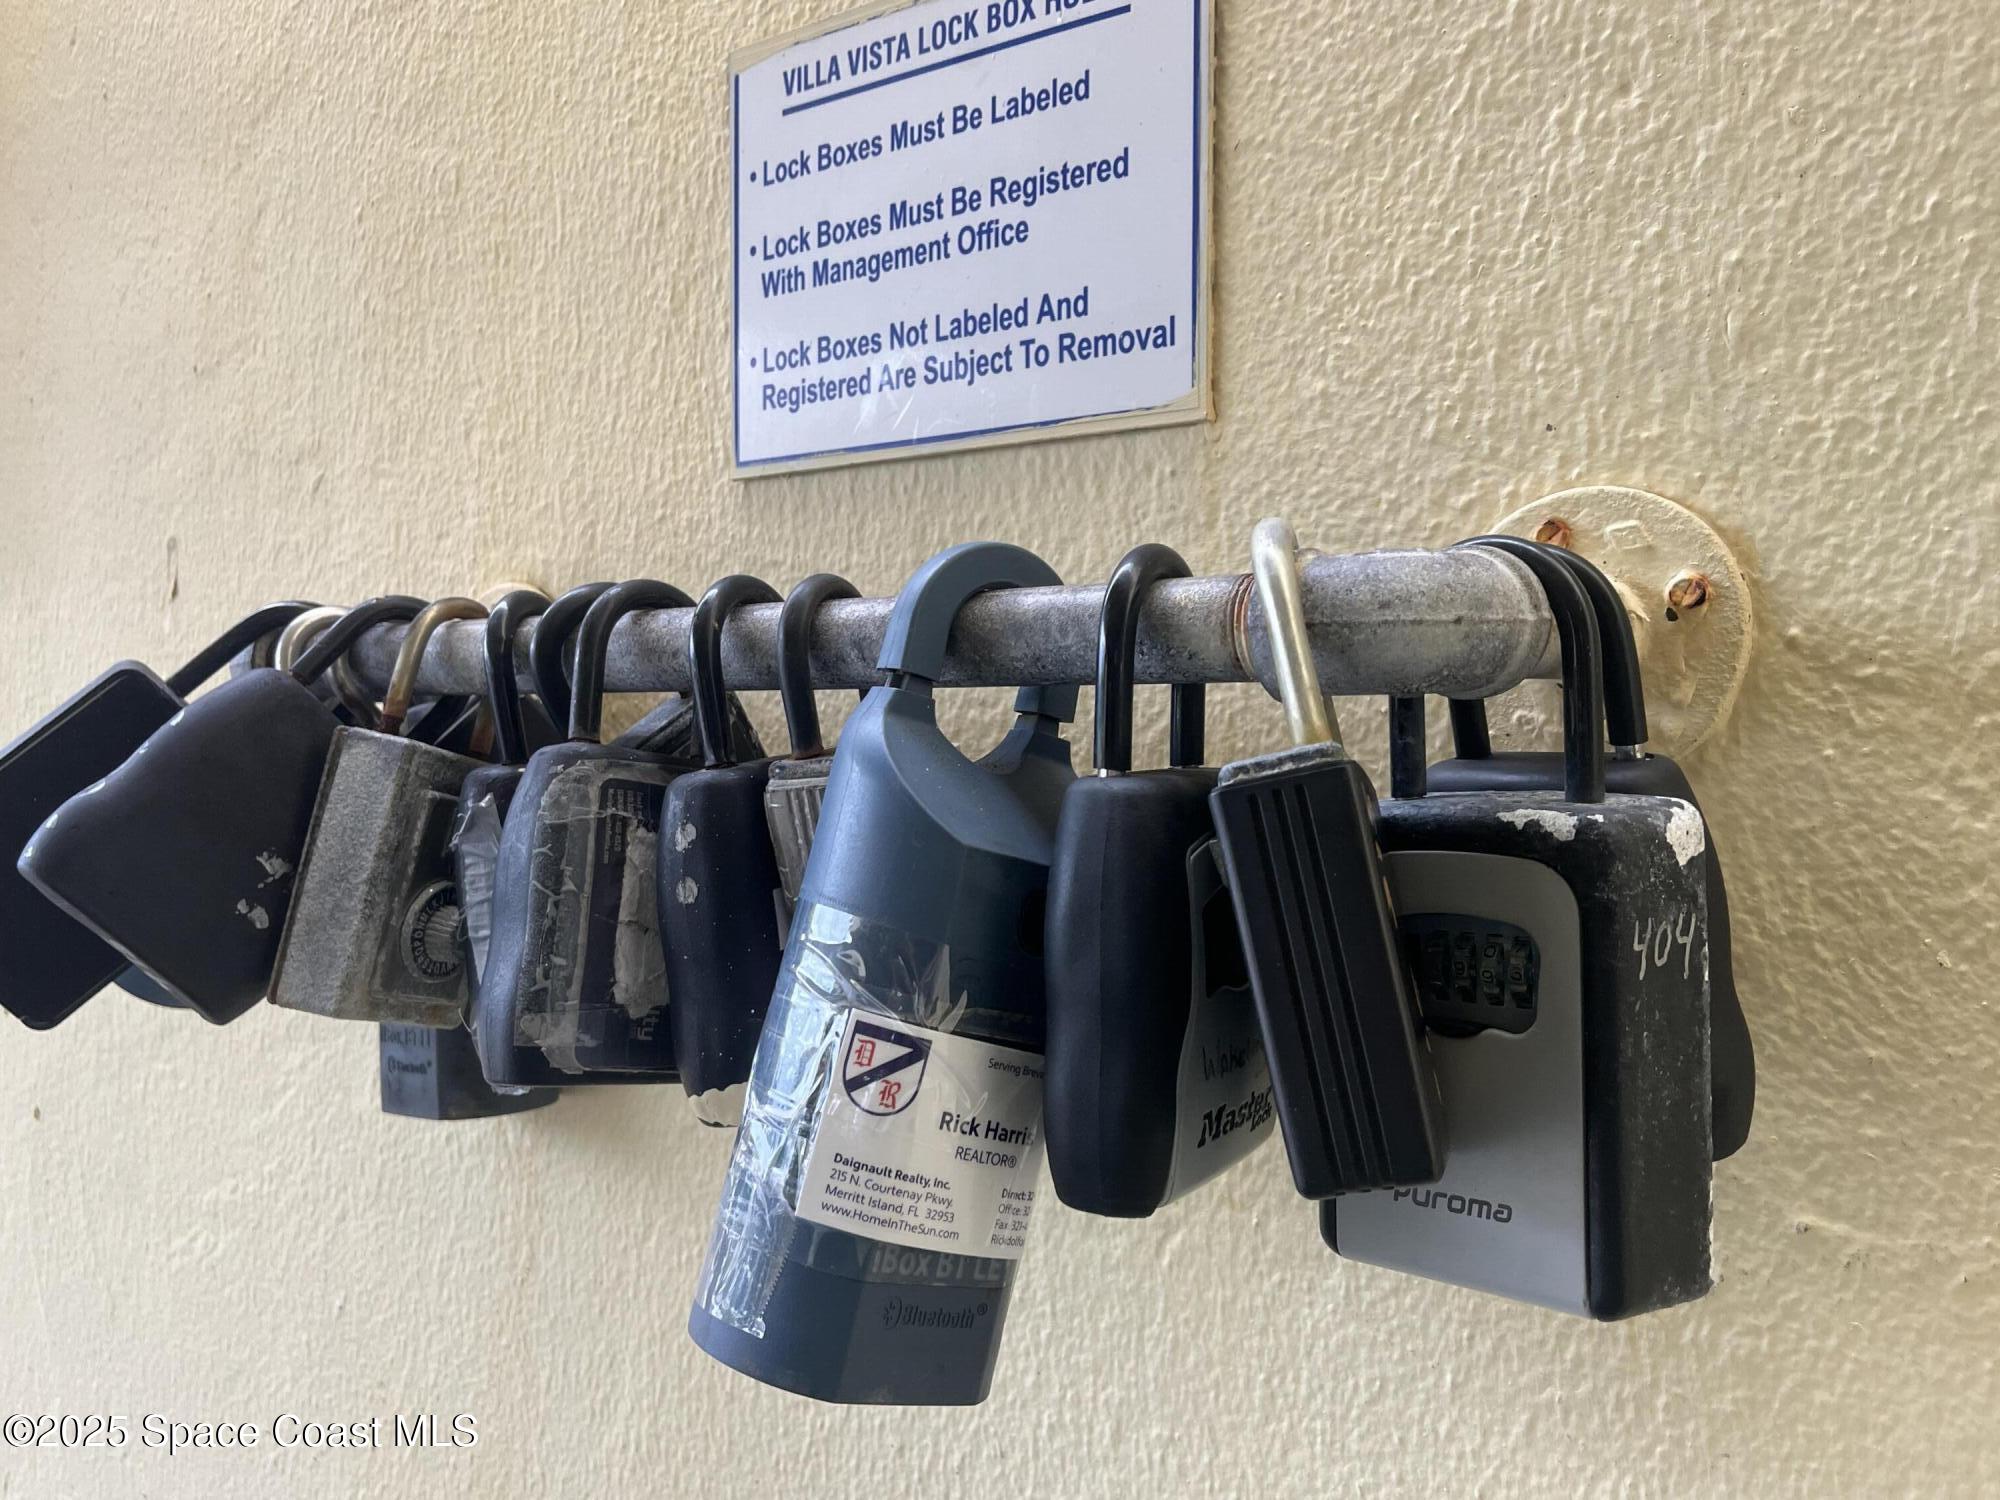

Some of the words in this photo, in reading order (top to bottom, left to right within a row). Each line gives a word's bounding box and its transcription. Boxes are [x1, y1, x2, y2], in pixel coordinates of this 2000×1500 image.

[783, 55, 841, 97] VILLA
[848, 33, 910, 78] VISTA
[919, 9, 979, 56] LOCK
[987, 0, 1036, 33] BOX
[763, 150, 811, 187] Lock
[817, 134, 882, 172] Boxes
[890, 112, 945, 153] Must
[952, 105, 982, 135] Be
[991, 69, 1090, 124] Labeled
[763, 226, 811, 261] Lock
[817, 212, 882, 248] Boxes
[889, 192, 944, 231] Must
[951, 185, 981, 216] Be
[989, 147, 1129, 207] Registered
[761, 266, 806, 298] With
[812, 232, 950, 288] Management
[957, 217, 1029, 255] Office
[763, 340, 811, 373] Lock
[817, 329, 882, 363] Boxes
[889, 318, 928, 351] Not
[935, 297, 1028, 342] Labeled
[1036, 286, 1089, 324] And
[762, 367, 871, 413] Registered
[878, 363, 916, 393] Are
[923, 343, 1012, 387] Subject
[1019, 338, 1050, 369] To
[1058, 315, 1176, 365] Removal
[1633, 913, 1697, 981] 404
[853, 1038, 876, 1067] D
[988, 1058, 1021, 1077] Serving
[879, 1080, 901, 1109] R
[1197, 1083, 1273, 1149] Master
[939, 1111, 981, 1137] Rick
[829, 1168, 848, 1183] 215
[849, 1175, 860, 1187] N.
[864, 1178, 922, 1203] Courtenay
[833, 1152, 892, 1178] Daignault
[894, 1169, 931, 1189] Realty,
[821, 1201, 960, 1240] www.HomeInTheSun.com
[825, 1184, 865, 1205] Merritt
[868, 1196, 904, 1216] Island,
[907, 1205, 919, 1217] FL
[925, 1208, 955, 1223] 32953
